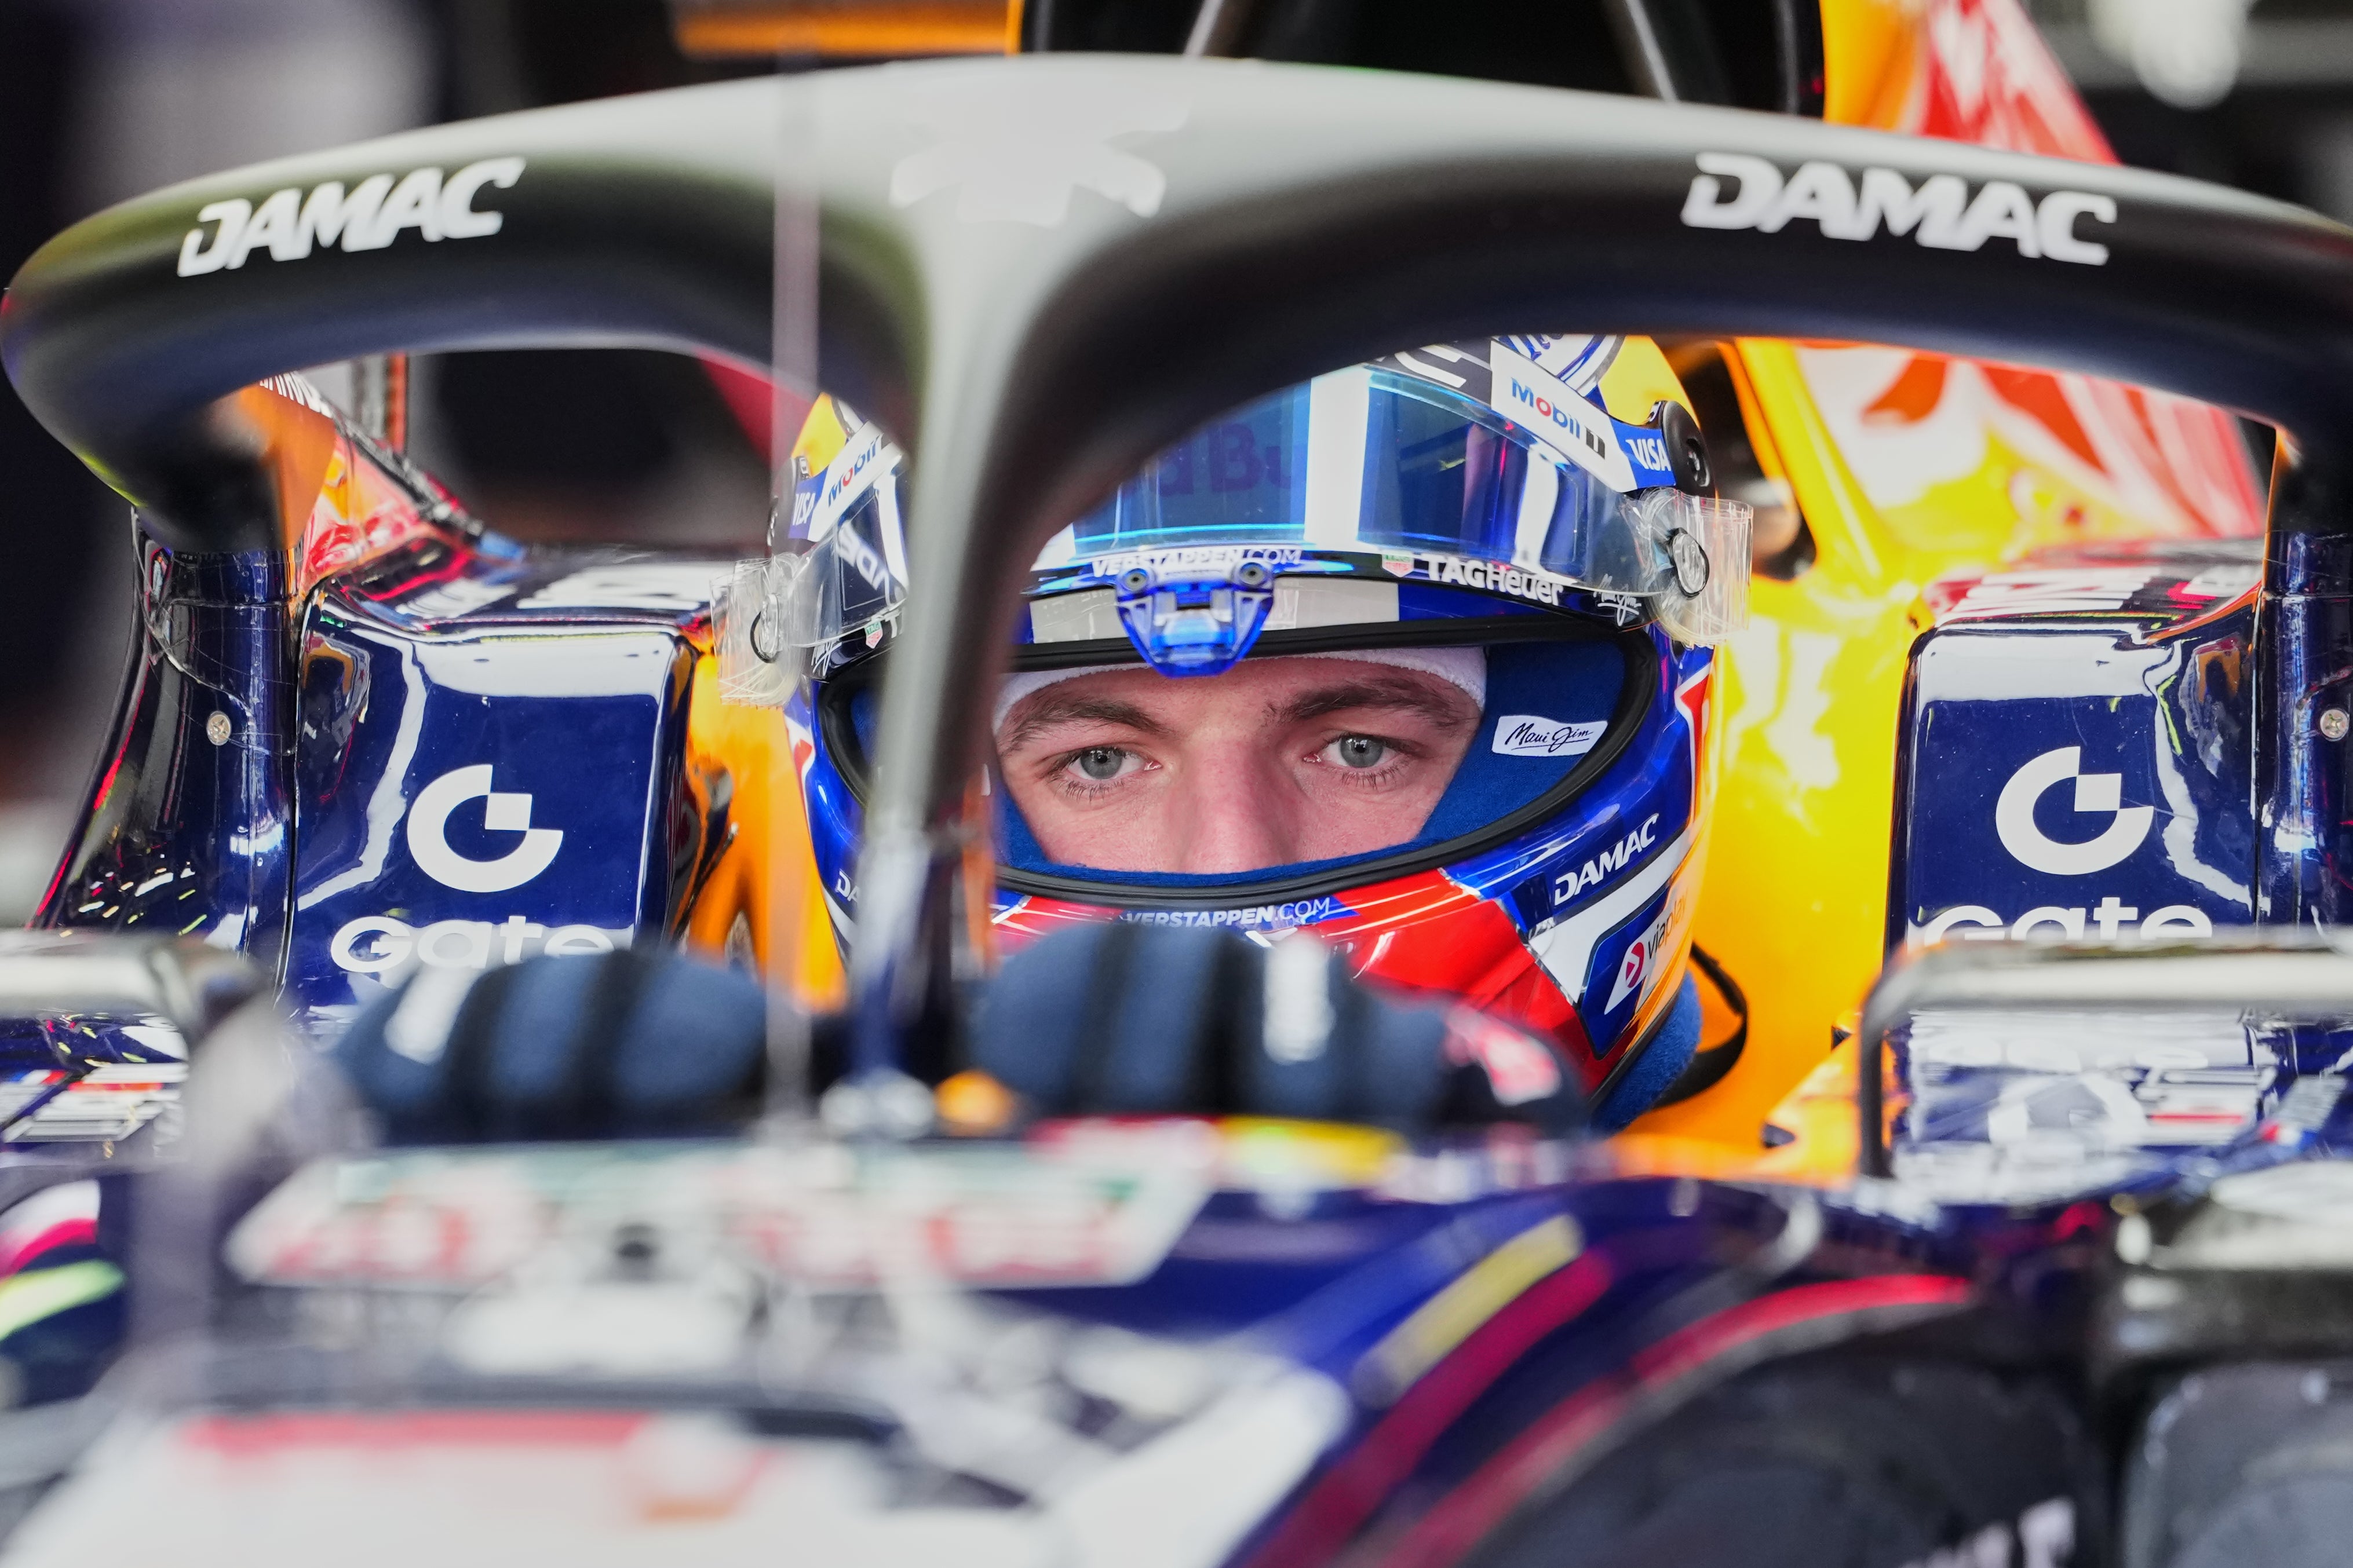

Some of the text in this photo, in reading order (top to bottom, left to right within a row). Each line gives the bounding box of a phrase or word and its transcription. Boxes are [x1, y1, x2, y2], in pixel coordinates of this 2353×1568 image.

[177, 157, 526, 277] DAMAC
[1681, 152, 2118, 266] DAMAC
[1511, 377, 1580, 439] Mobil
[828, 434, 881, 507] Mobil
[1625, 438, 1672, 472] VISA
[792, 492, 816, 526] VISA
[1504, 723, 1593, 753] Maui Jim
[1553, 813, 1659, 906] DAMAC
[1128, 897, 1332, 927] VERSTAPPEN.COM
